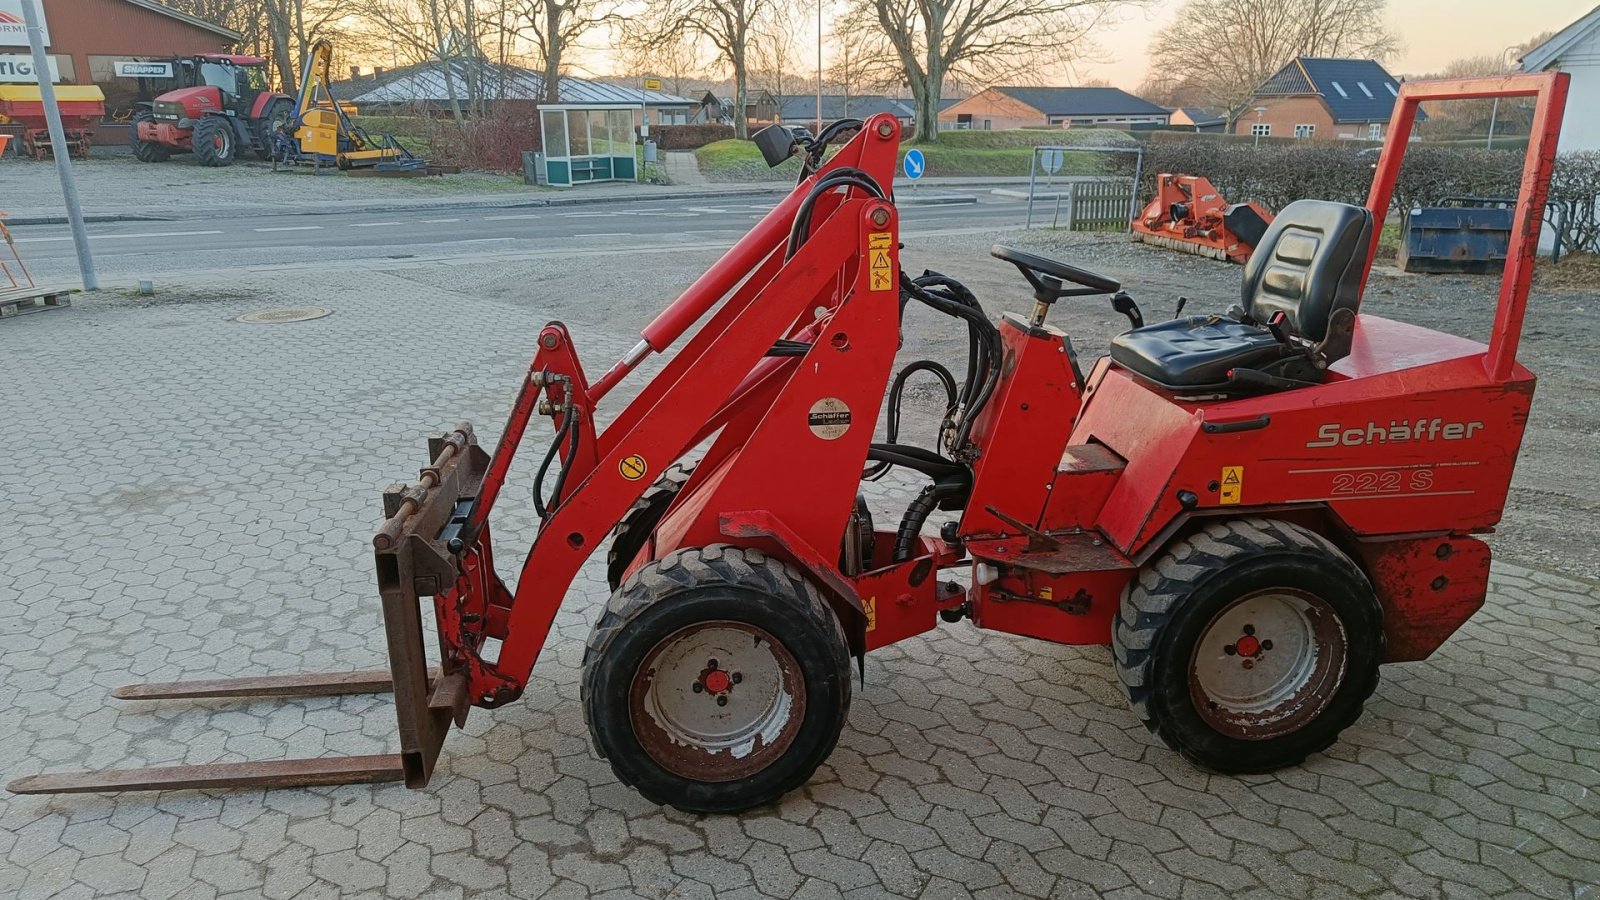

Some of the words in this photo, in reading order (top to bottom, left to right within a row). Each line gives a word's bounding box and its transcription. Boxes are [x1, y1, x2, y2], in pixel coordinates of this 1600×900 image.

[0, 61, 37, 75] TIG
[124, 65, 165, 74] SNAPPER
[1306, 418, 1484, 448] Schäffer
[1331, 471, 1401, 495] 222
[1409, 469, 1433, 491] S
